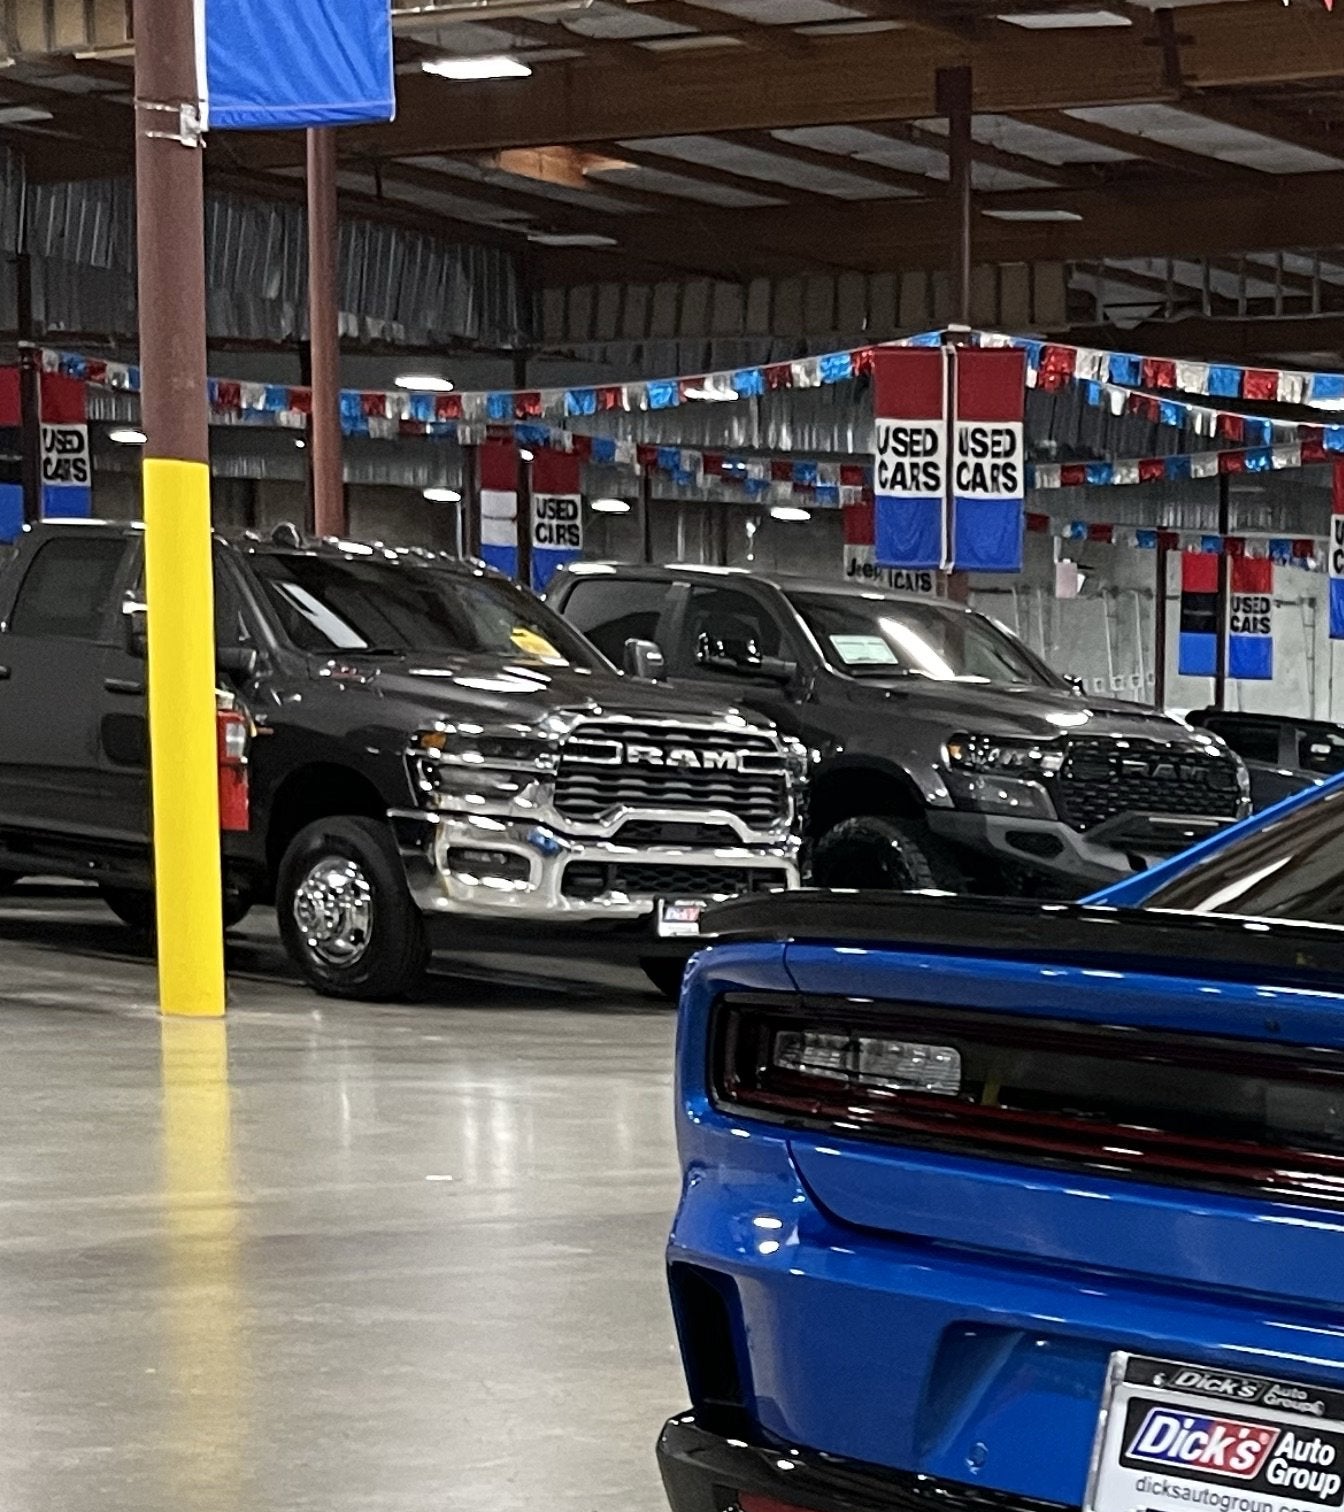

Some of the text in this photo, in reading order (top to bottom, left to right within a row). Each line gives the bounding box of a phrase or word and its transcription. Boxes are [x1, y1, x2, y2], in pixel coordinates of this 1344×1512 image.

[876, 425, 939, 458] USED
[958, 427, 1017, 459] USED
[876, 459, 941, 492] CARS
[956, 461, 1018, 493] CARS
[535, 497, 579, 520] USED
[1231, 596, 1271, 614] USED
[626, 744, 738, 770] RAM
[1174, 1369, 1259, 1399] Dick's
[1138, 1413, 1336, 1472] Dick's Auto
[1265, 1457, 1342, 1501] Group
